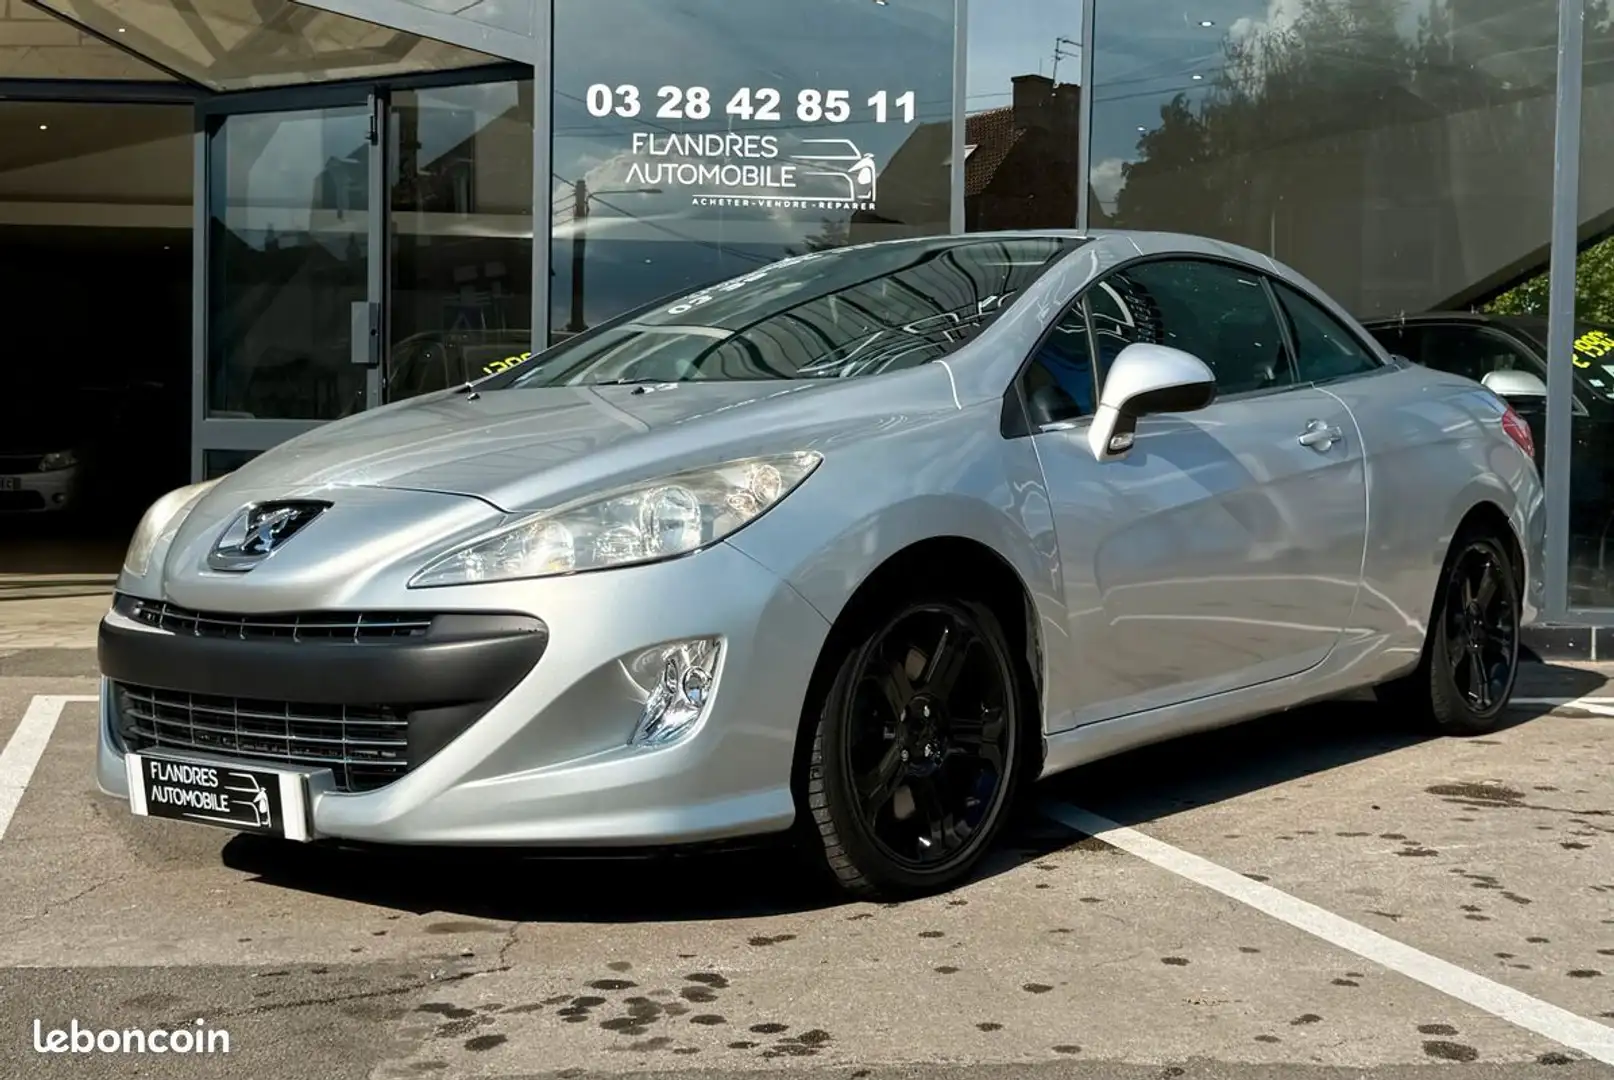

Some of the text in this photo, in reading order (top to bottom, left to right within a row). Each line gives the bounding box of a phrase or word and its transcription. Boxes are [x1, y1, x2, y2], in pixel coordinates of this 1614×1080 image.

[586, 83, 916, 124] 03 28 42 85 11
[632, 132, 779, 159] FLANDRES
[625, 162, 797, 188] AUTOMOBILE
[150, 761, 219, 788] FLANDRES
[150, 784, 231, 813] AUTOMOBILE
